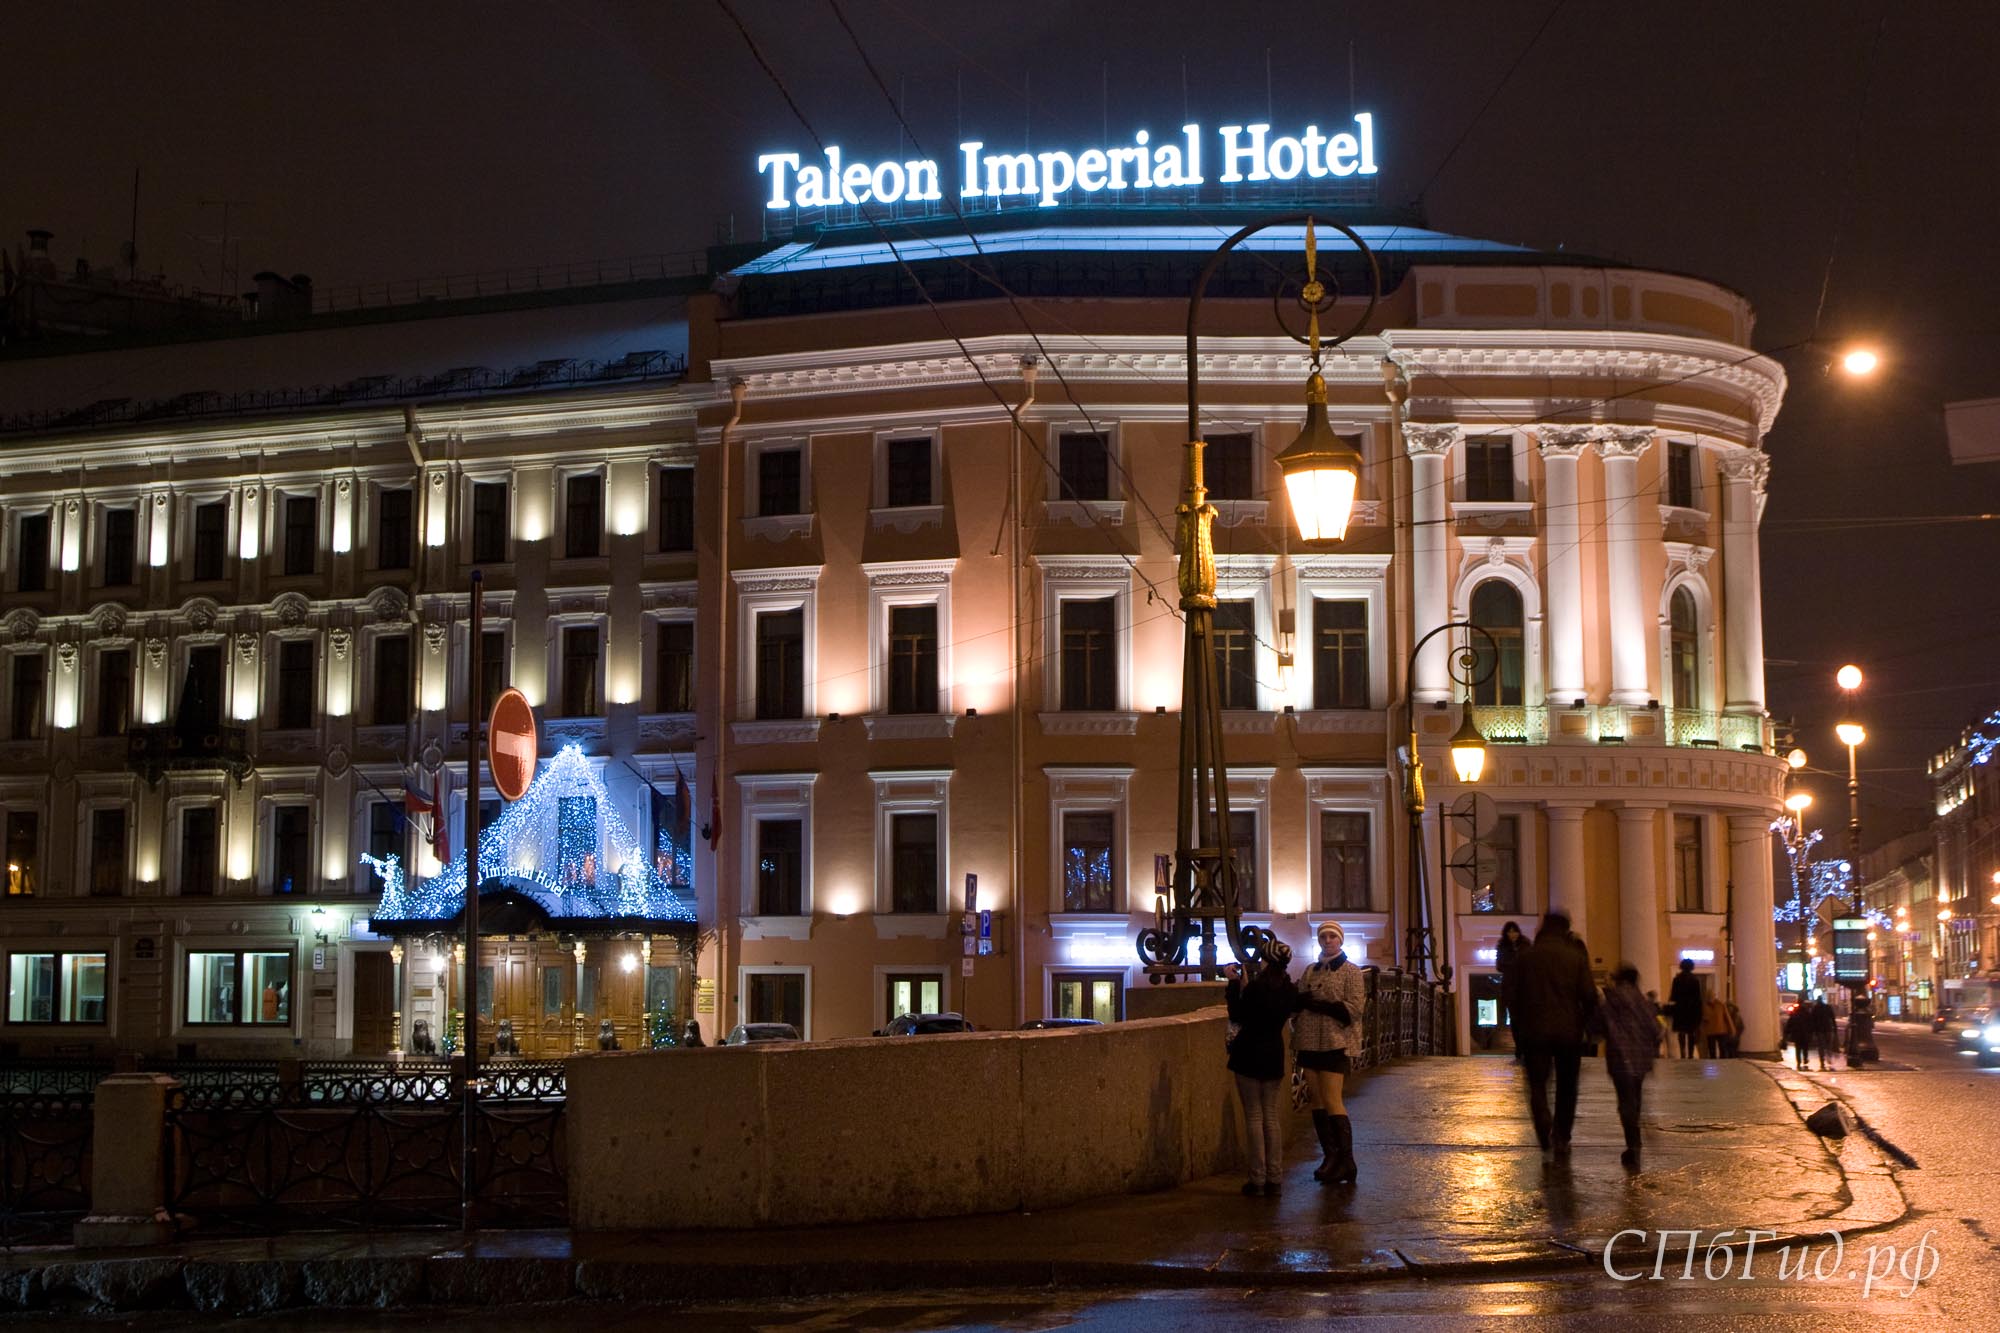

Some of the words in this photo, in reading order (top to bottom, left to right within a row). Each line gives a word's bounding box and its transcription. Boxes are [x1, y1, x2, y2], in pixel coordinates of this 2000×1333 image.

[758, 145, 942, 210] Taleon
[959, 124, 1204, 208] Imperial
[1218, 112, 1379, 184] Hotel
[484, 863, 535, 881] Imperial
[535, 869, 568, 898] Hotel
